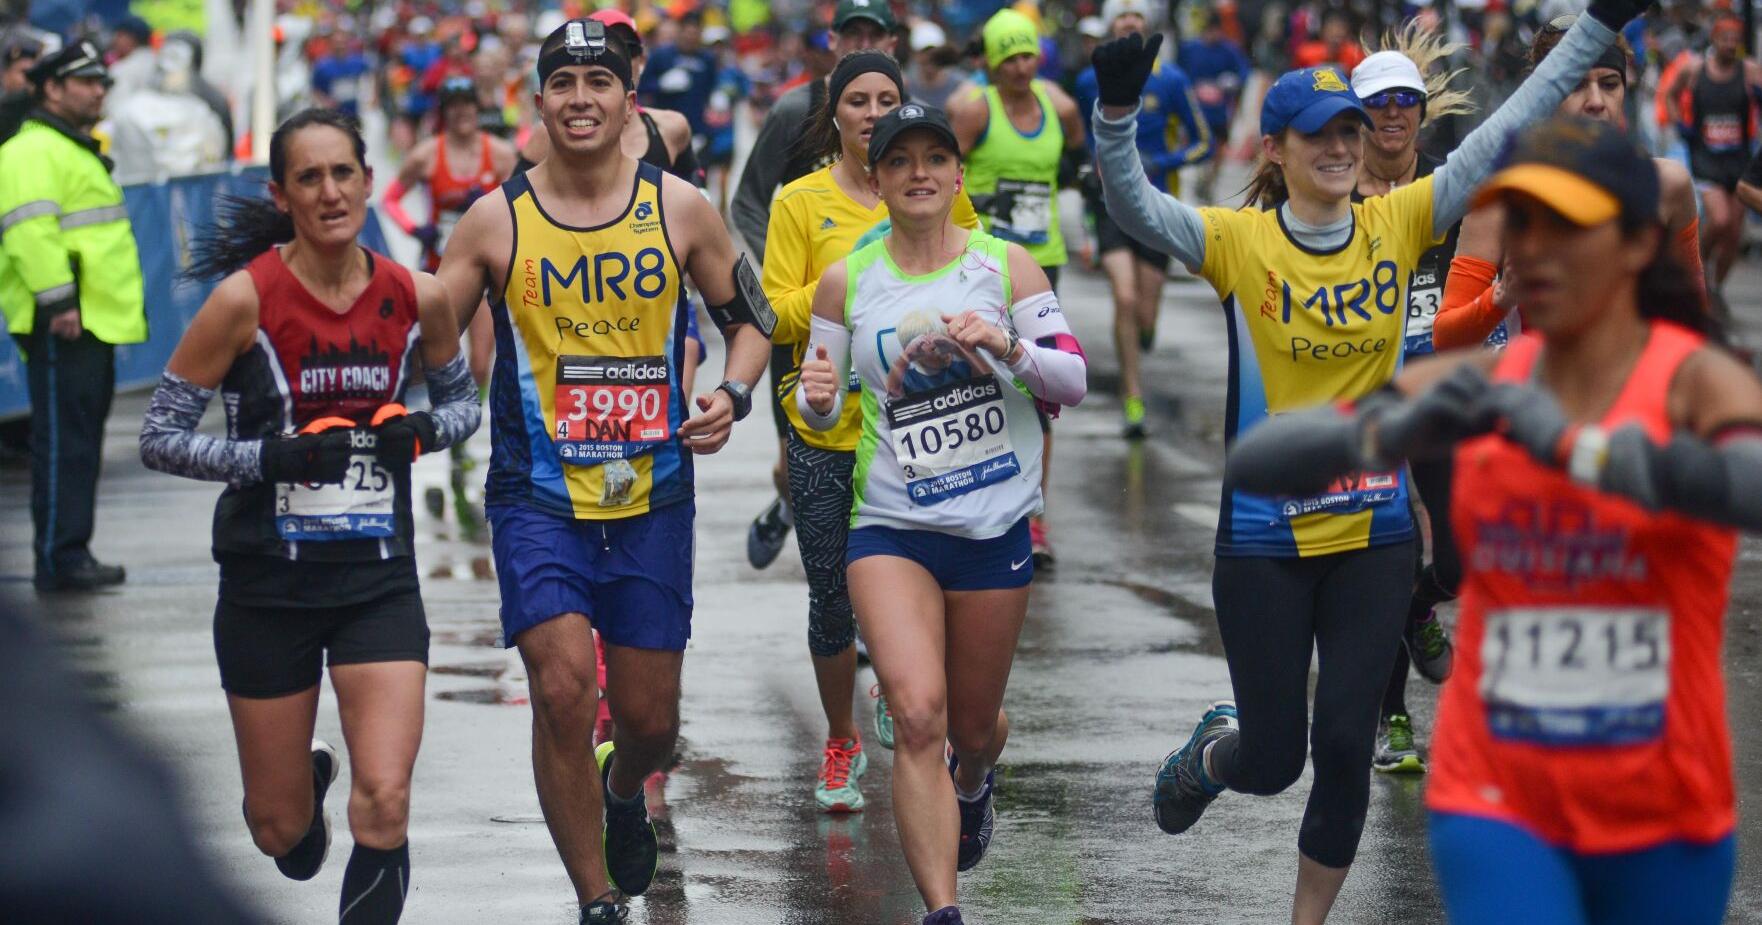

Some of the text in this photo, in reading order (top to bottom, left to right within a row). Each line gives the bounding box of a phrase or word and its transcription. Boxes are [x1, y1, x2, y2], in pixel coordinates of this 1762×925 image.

[522, 259, 538, 308] Team
[541, 247, 667, 307] MR8
[1261, 270, 1278, 322] Team
[1282, 260, 1400, 326] MR8
[555, 316, 640, 340] Peace
[1291, 337, 1386, 362] Peace
[301, 367, 337, 393] CITY
[341, 366, 389, 391] COACH
[606, 364, 667, 379] adidas
[568, 388, 660, 421] 3990
[933, 384, 997, 411] adidas
[557, 421, 568, 438] 4
[585, 419, 632, 442] DAN
[901, 406, 1005, 460] 10580
[578, 451, 623, 459] MARATHON
[904, 465, 916, 479] 3
[930, 469, 973, 488] 2015 BOSTON
[931, 477, 975, 495] MARATHON
[280, 496, 289, 513] 3
[1321, 495, 1350, 505] BOSTON
[1496, 617, 1660, 671] 11215
